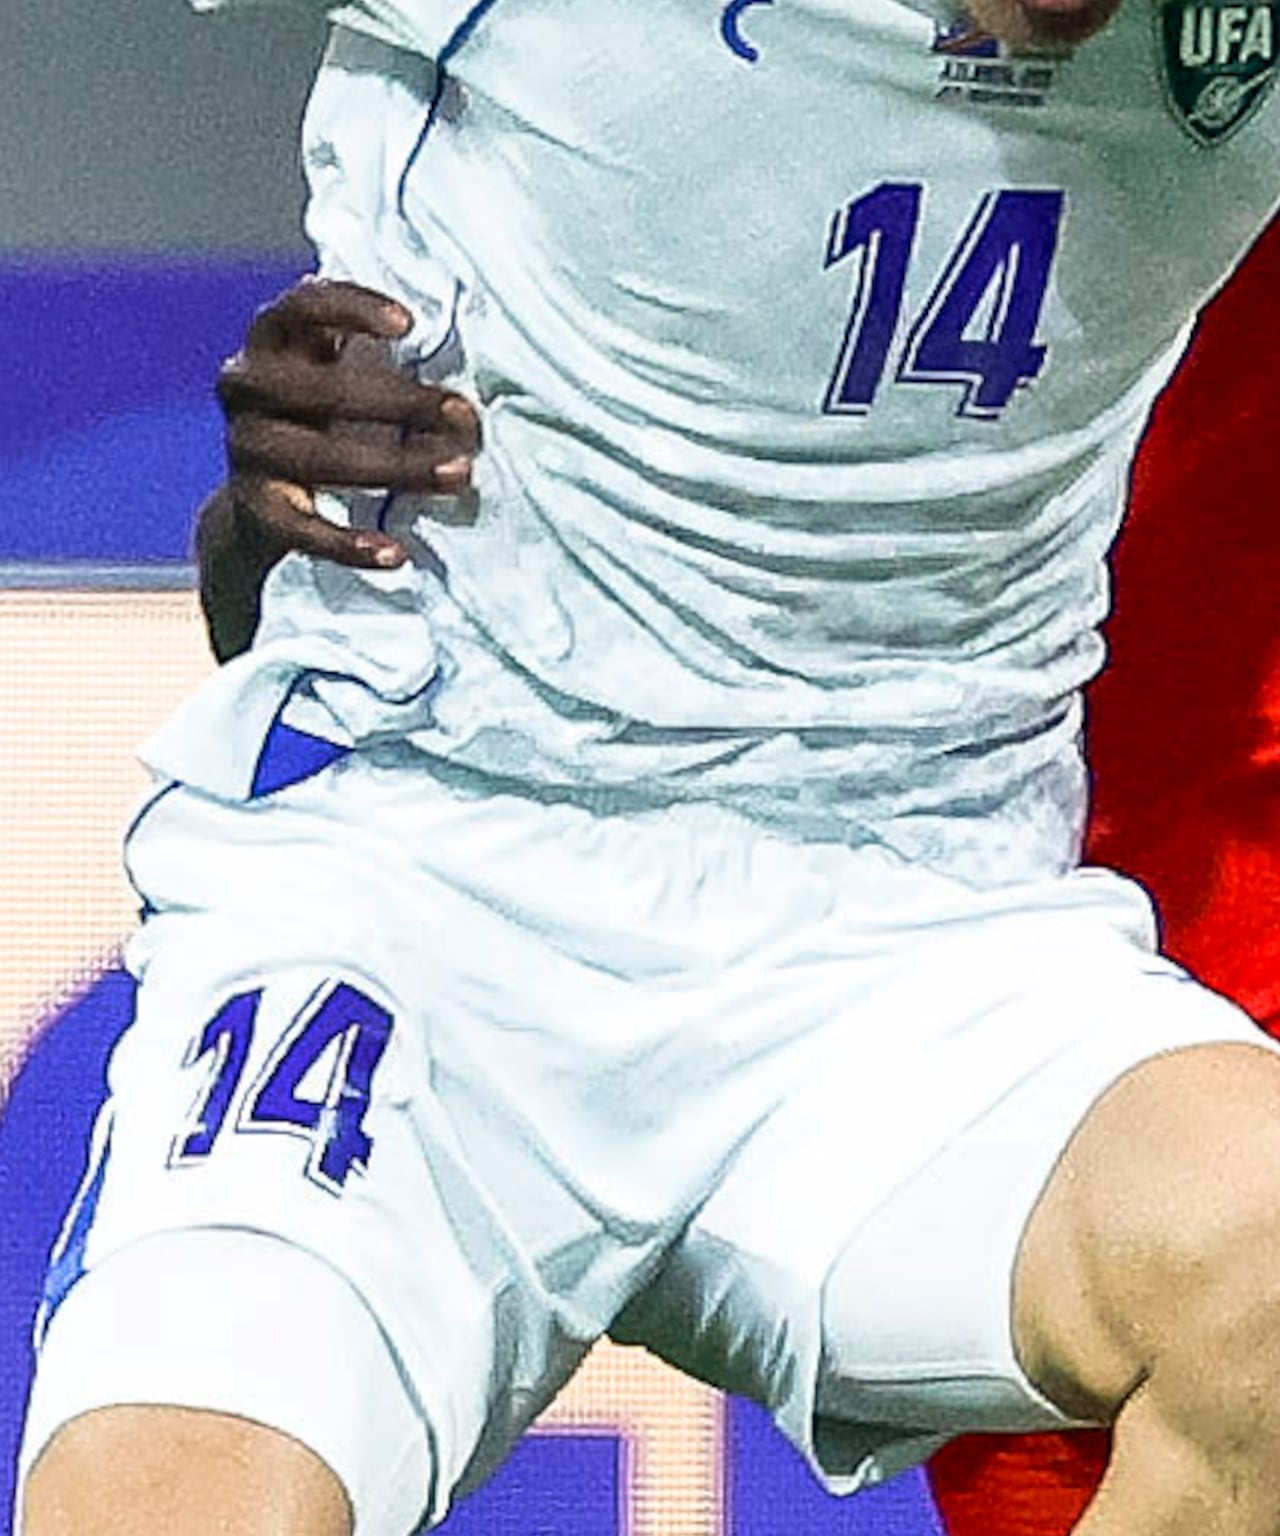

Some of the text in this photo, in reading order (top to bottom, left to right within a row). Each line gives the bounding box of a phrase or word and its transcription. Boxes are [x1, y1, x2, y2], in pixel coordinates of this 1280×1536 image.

[1179, 5, 1273, 68] UFA
[823, 180, 1066, 420] 14
[166, 977, 396, 1200] 14
